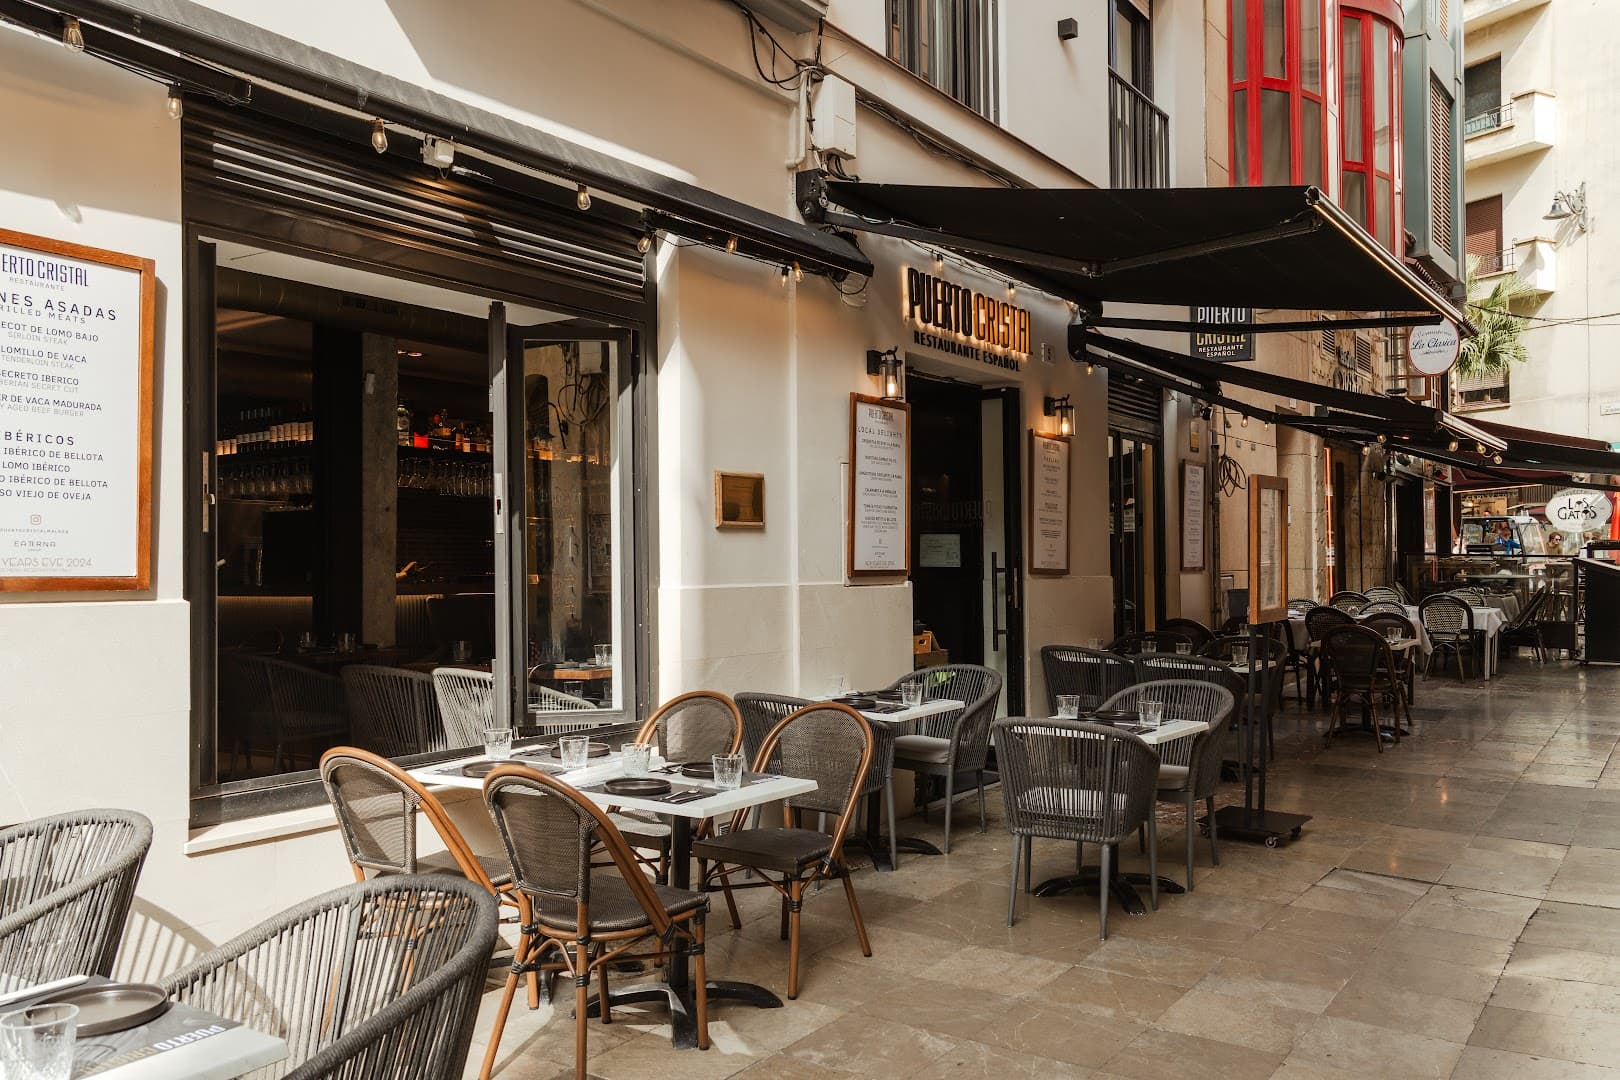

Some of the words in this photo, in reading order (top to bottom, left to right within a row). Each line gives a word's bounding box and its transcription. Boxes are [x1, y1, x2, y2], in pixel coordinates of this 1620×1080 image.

[38, 260, 89, 287] CRISTAL
[44, 299, 117, 321] ASADAS
[48, 312, 86, 324] MEATS
[908, 267, 972, 336] PUERTO
[973, 293, 1033, 355] CRISTAL
[1197, 307, 1246, 324] PUERTO
[30, 325, 43, 334] DE
[46, 328, 72, 339] LOMO
[75, 332, 99, 343] BAJO
[914, 331, 980, 361] RESTAURANTE
[983, 351, 1020, 372] ESPAÑOL
[1198, 344, 1244, 353] RESTAURANTE
[47, 351, 60, 360] DE
[62, 354, 87, 363] VACA
[0, 370, 39, 381] ECRETO
[41, 374, 79, 386] IBERICO
[10, 394, 23, 403] DE
[25, 396, 50, 406] VACA
[53, 399, 102, 412] MADURADA
[0, 428, 75, 446] BÉRICOS
[4, 446, 46, 458] IBÉRICO
[49, 451, 61, 459] DE
[64, 452, 104, 461] BELLOTA
[2, 461, 29, 470] LOMO
[32, 461, 71, 473] IBÉRICO
[9, 474, 51, 486] IBÉRICO
[54, 478, 66, 487] DE
[69, 479, 108, 488] BELLOTA
[16, 490, 45, 498] VIEJO
[62, 492, 92, 501] OVEJA
[1568, 497, 1589, 510] LOS
[1557, 505, 1597, 521] GATOS
[66, 557, 92, 568] 2024
[153, 1025, 226, 1051] PUERTO
